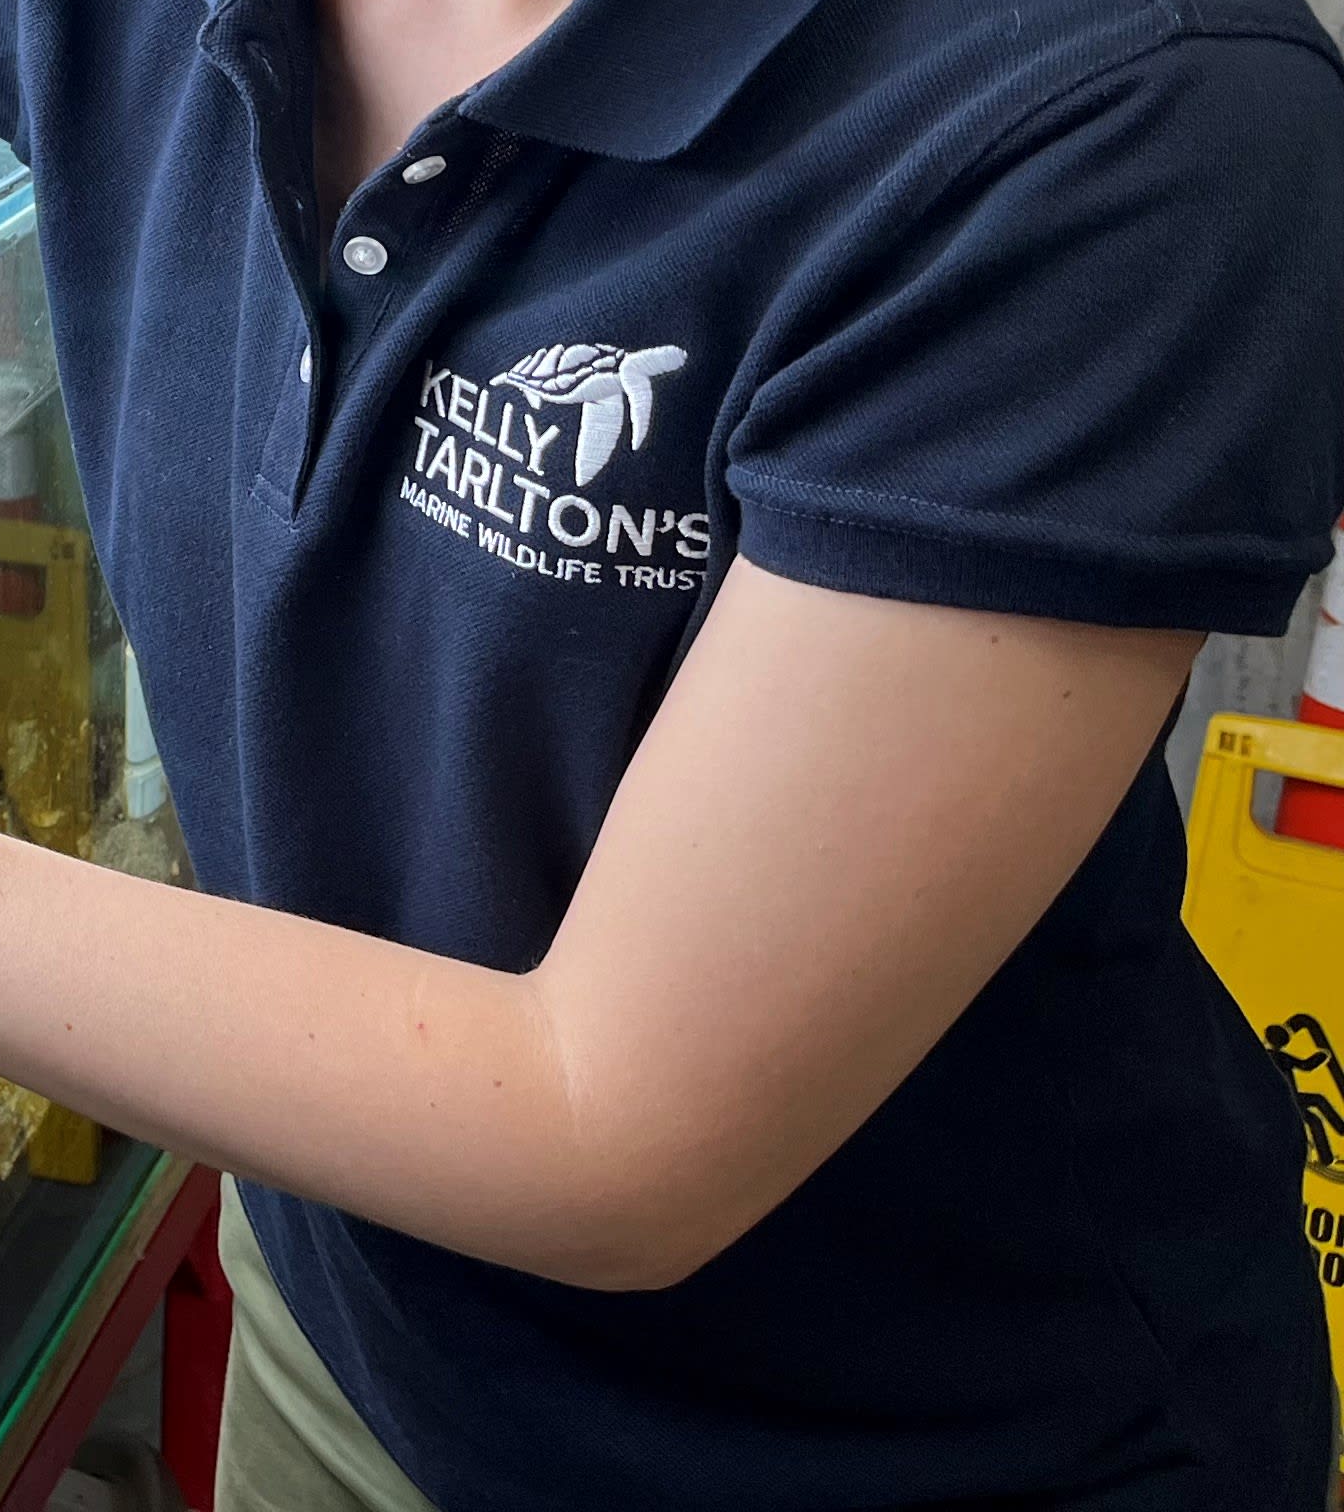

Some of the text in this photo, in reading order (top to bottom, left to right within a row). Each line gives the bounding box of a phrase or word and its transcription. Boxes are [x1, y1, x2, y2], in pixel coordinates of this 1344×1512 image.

[420, 360, 560, 476] KELLY
[399, 476, 472, 539] MARINE
[478, 522, 602, 584] WILDLIFE
[413, 416, 710, 560] TARLTON'S
